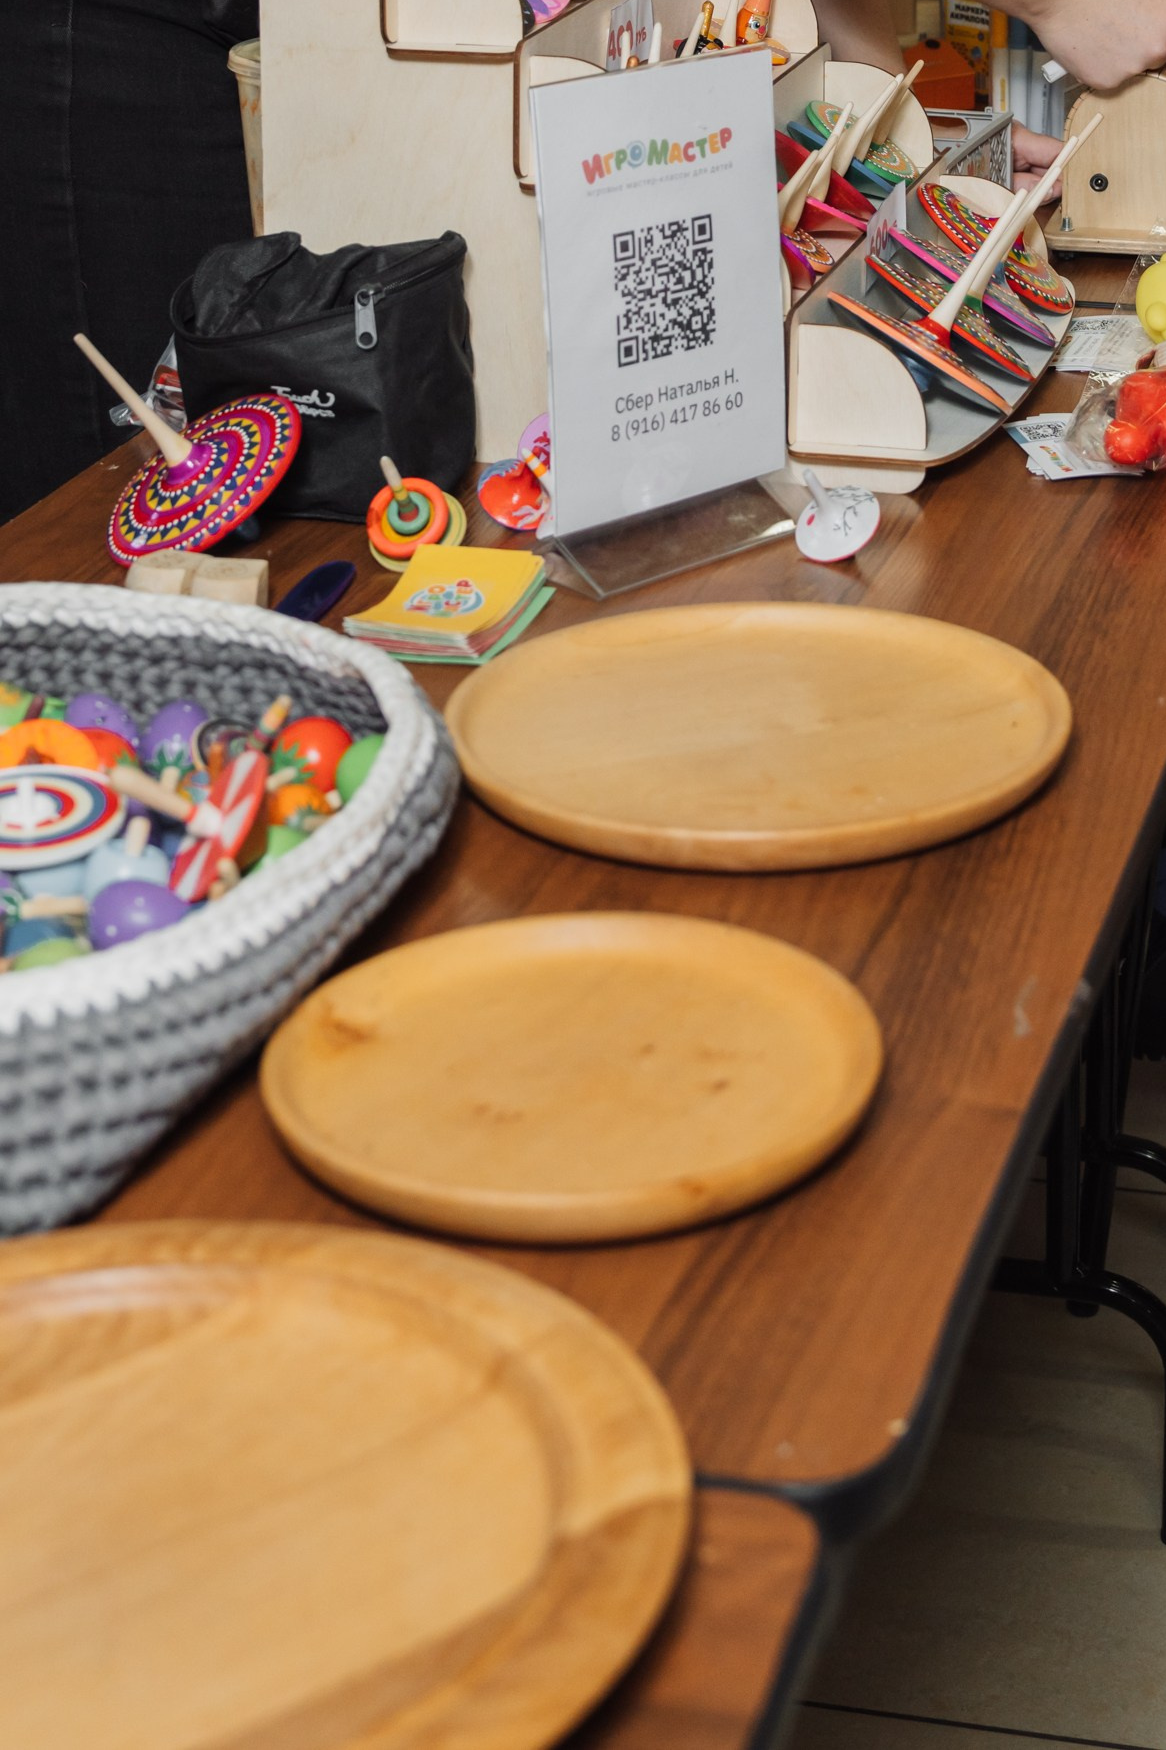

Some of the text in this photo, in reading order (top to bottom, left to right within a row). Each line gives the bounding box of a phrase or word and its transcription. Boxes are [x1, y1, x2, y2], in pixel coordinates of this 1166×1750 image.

[615, 367, 739, 414] Сбер Наталья Н.
[611, 391, 743, 442] 8 (916) 417 86 60
